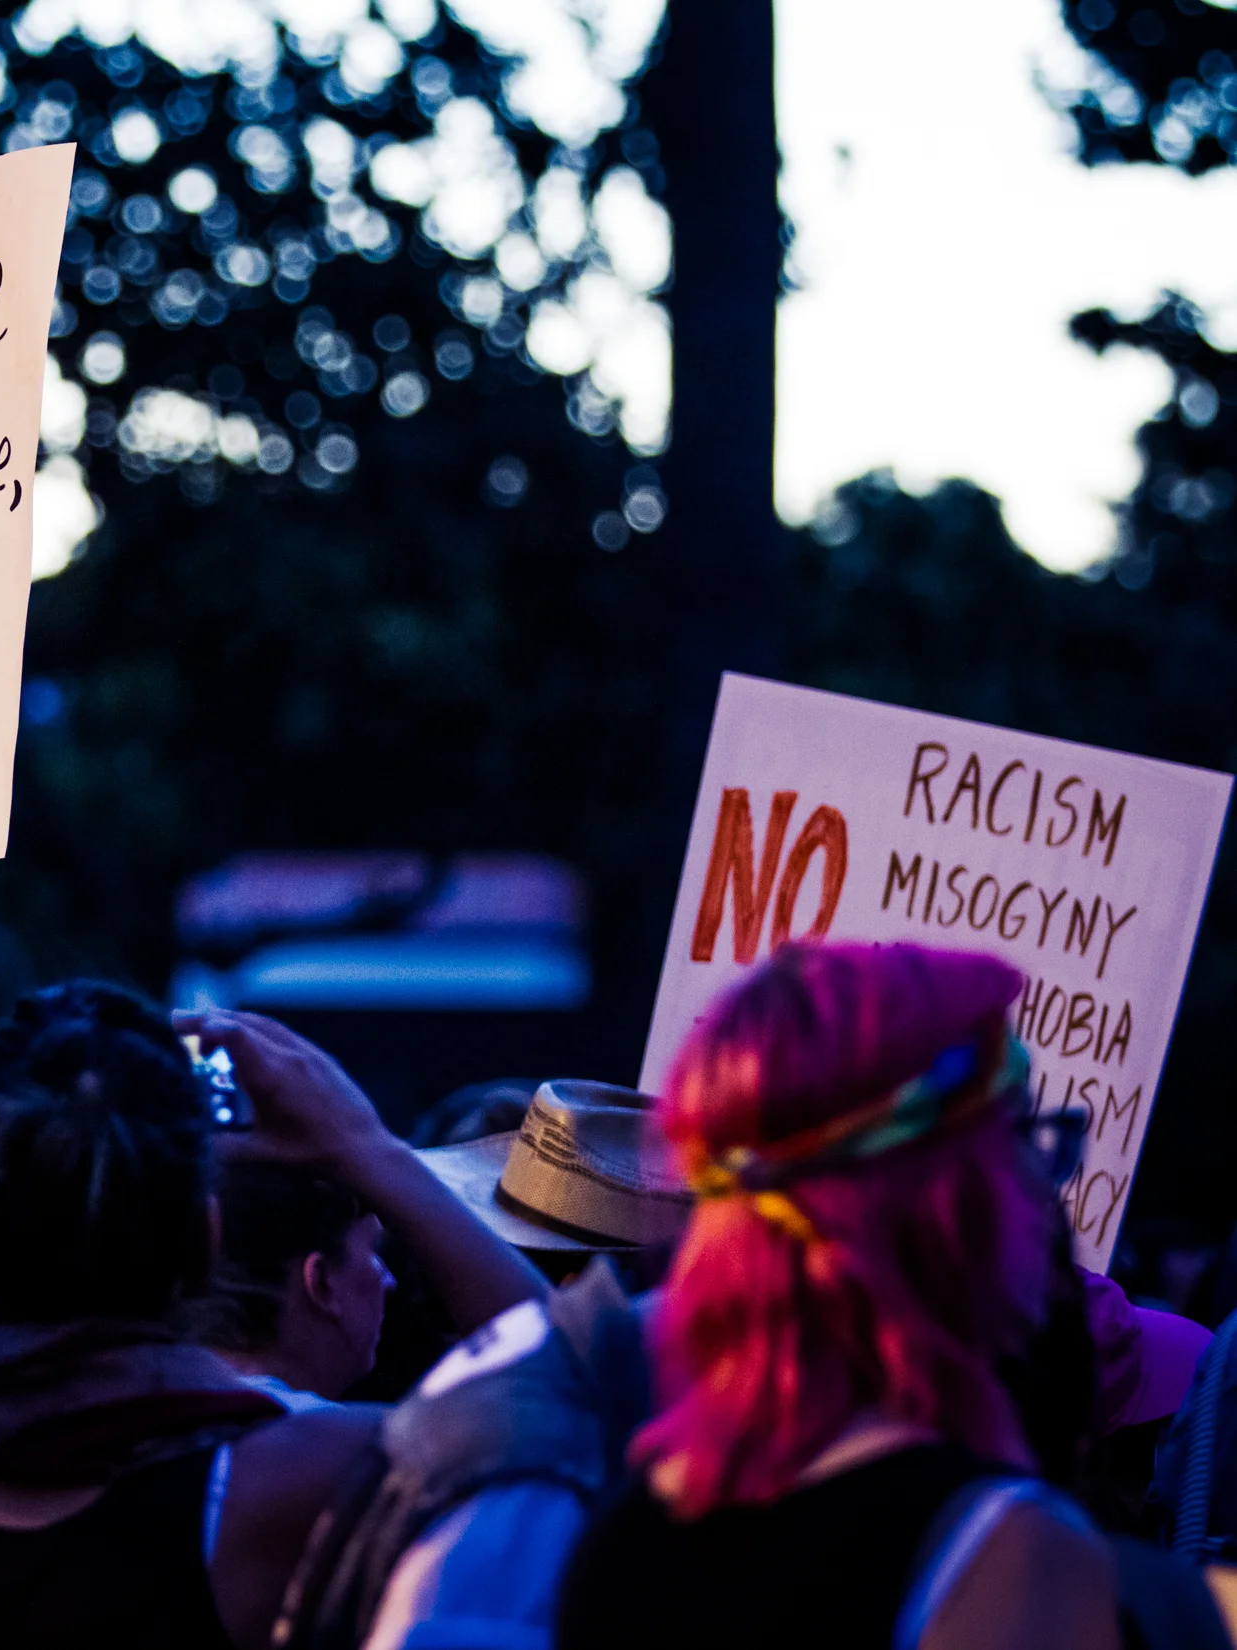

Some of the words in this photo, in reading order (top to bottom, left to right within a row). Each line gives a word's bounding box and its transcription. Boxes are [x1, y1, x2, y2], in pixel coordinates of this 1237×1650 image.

[903, 741, 1128, 869] RACISM
[690, 786, 849, 964] NO
[881, 849, 1138, 982] MISOGYNY
[1015, 974, 1132, 1068] HOBIA
